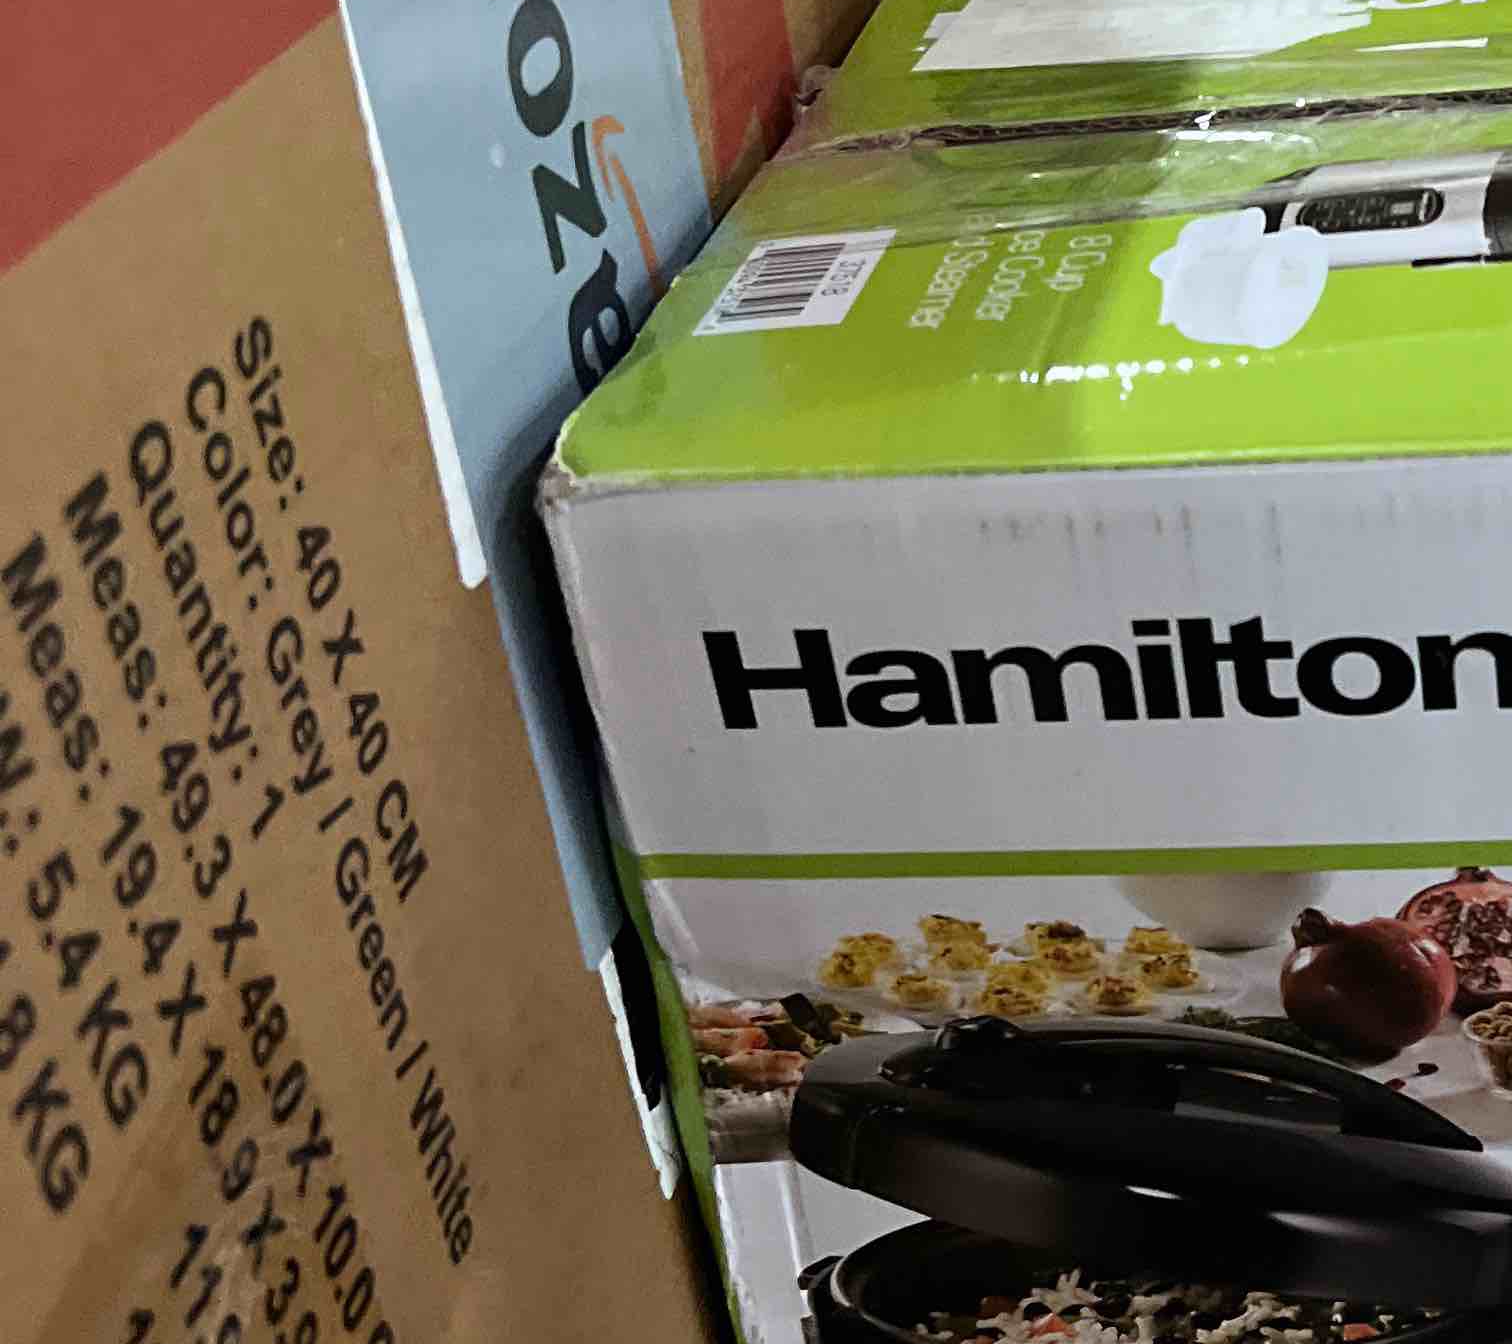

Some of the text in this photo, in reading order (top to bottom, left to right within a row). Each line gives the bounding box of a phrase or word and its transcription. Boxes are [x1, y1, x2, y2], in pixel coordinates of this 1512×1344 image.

[1, 528, 110, 803] Meas:
[103, 804, 182, 976] 19.4
[157, 960, 207, 1057] X
[242, 1186, 286, 1269] X
[62, 469, 169, 733] Meas:
[158, 740, 233, 900] 49.3
[210, 887, 257, 978] X
[240, 975, 307, 1124] 48.0
[287, 1104, 333, 1198] X
[311, 1183, 376, 1332] 10.0
[128, 420, 286, 840] Quantity: 1
[185, 367, 276, 611] Color:
[267, 615, 334, 797] Grey
[336, 836, 408, 1052] Green
[409, 1068, 473, 1265] White
[234, 316, 430, 904] Size: 40 X 40 CM
[12, 1059, 90, 1213] KG
[27, 851, 99, 989] 5.4
[76, 978, 148, 1130] KG
